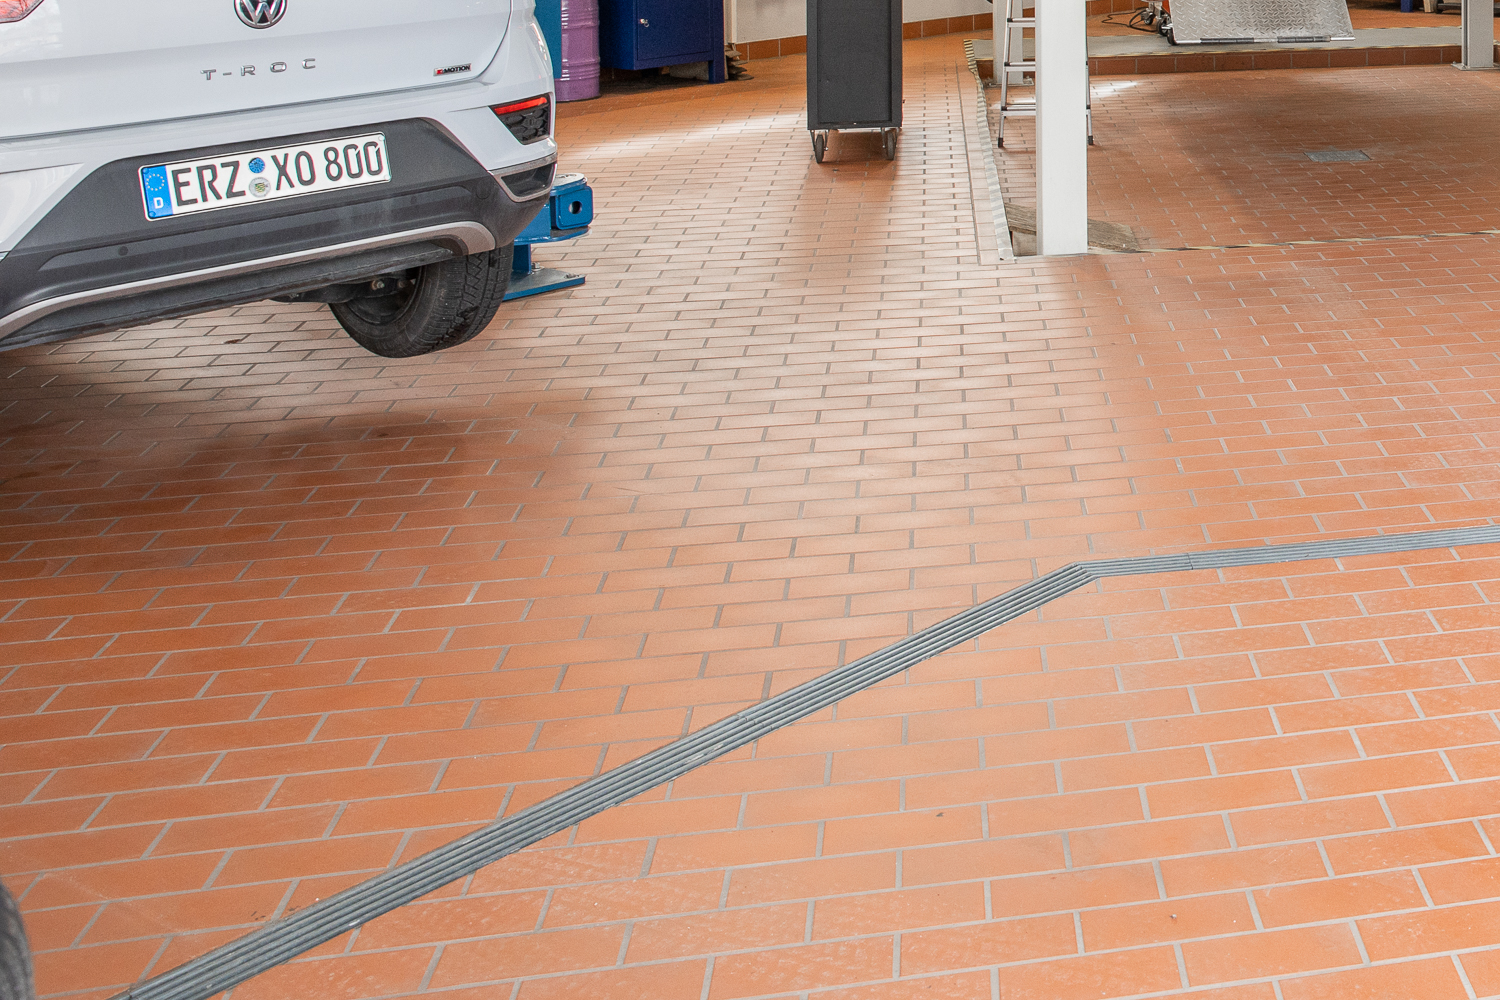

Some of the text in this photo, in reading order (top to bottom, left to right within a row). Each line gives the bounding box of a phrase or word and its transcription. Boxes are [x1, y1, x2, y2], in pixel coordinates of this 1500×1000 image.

[200, 58, 316, 81] T-ROC
[171, 141, 384, 207] ERZ XO 800
[154, 197, 164, 209] D
